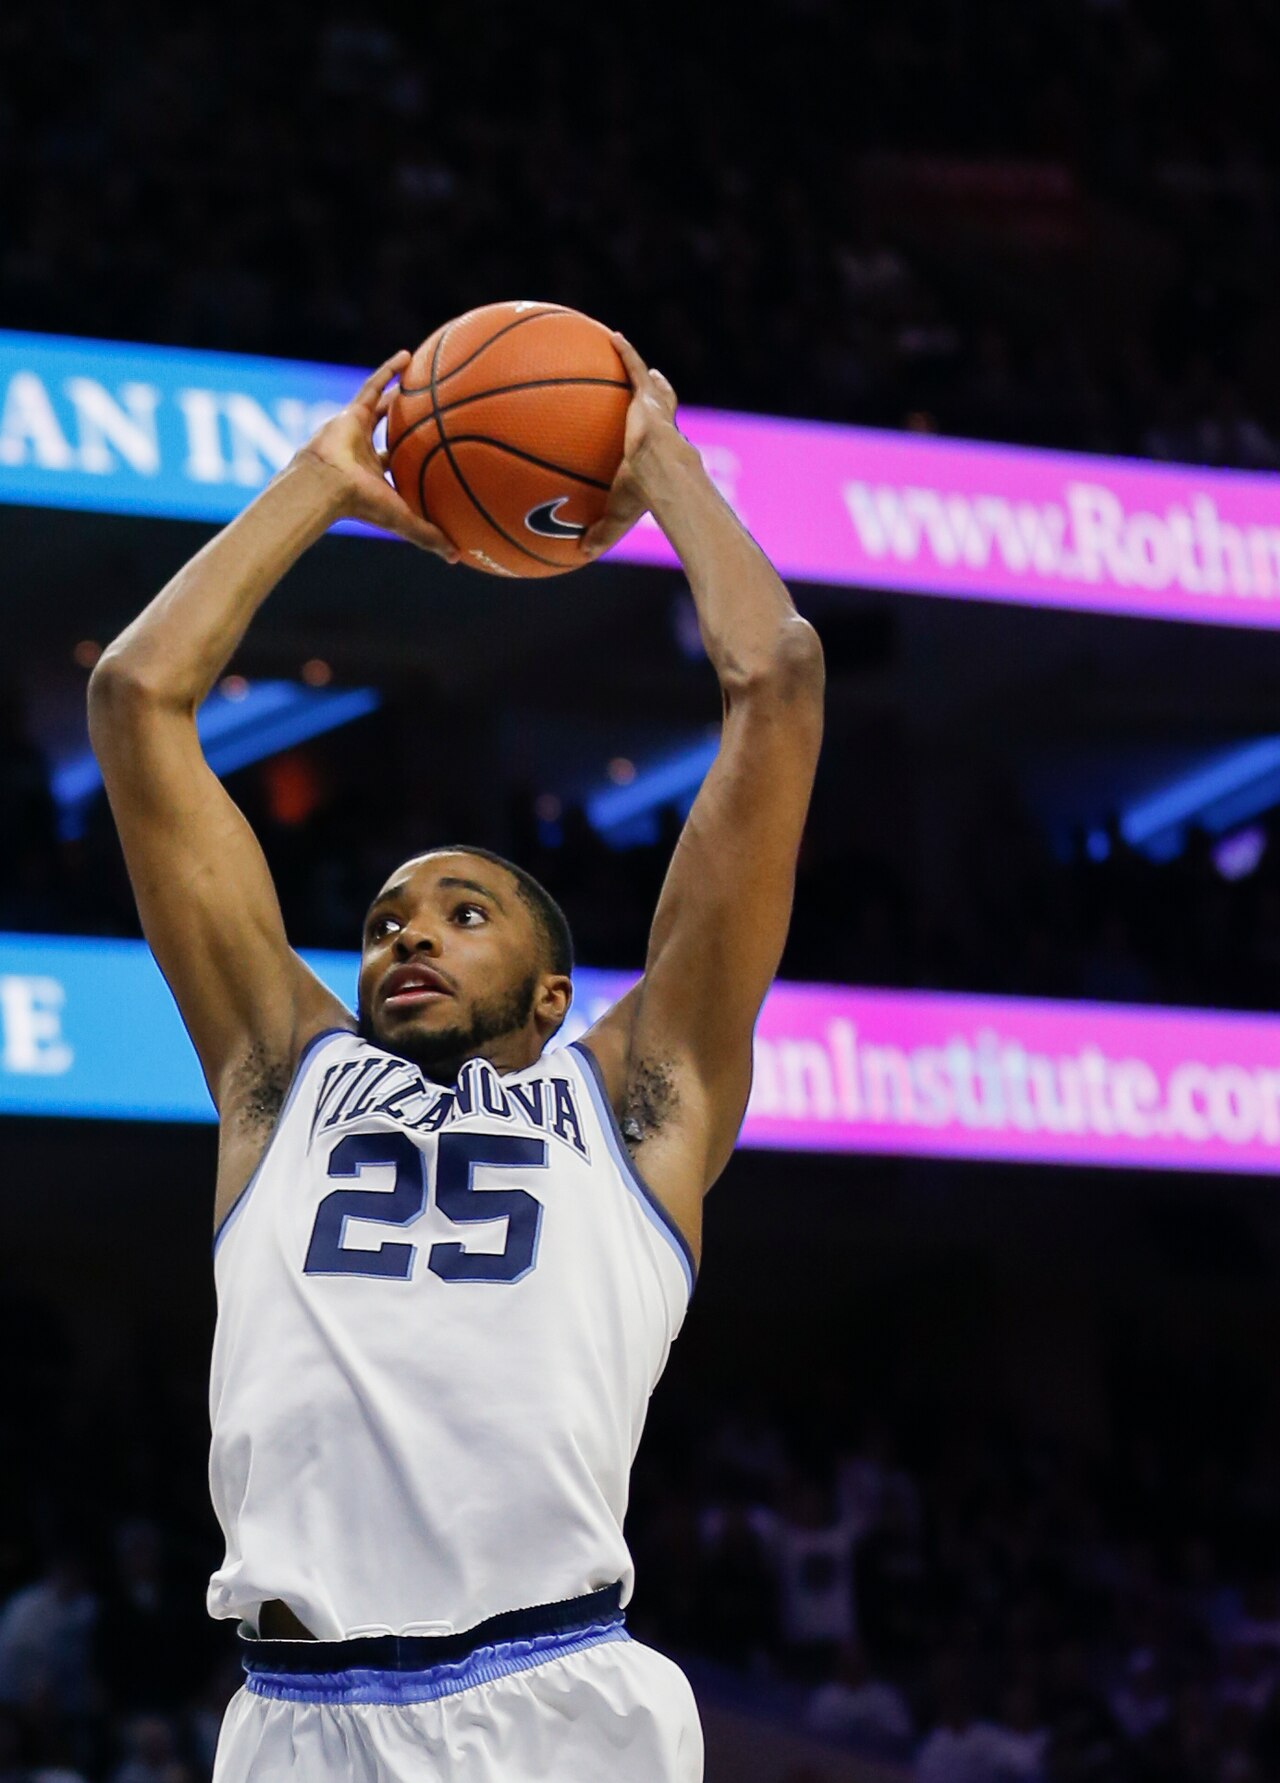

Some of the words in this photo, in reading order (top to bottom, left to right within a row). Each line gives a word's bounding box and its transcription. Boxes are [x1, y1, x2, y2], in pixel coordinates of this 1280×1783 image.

[307, 1057, 591, 1164] VILLANOVA
[751, 1017, 1280, 1148] nInstitute.co
[303, 1131, 549, 1284] 25
